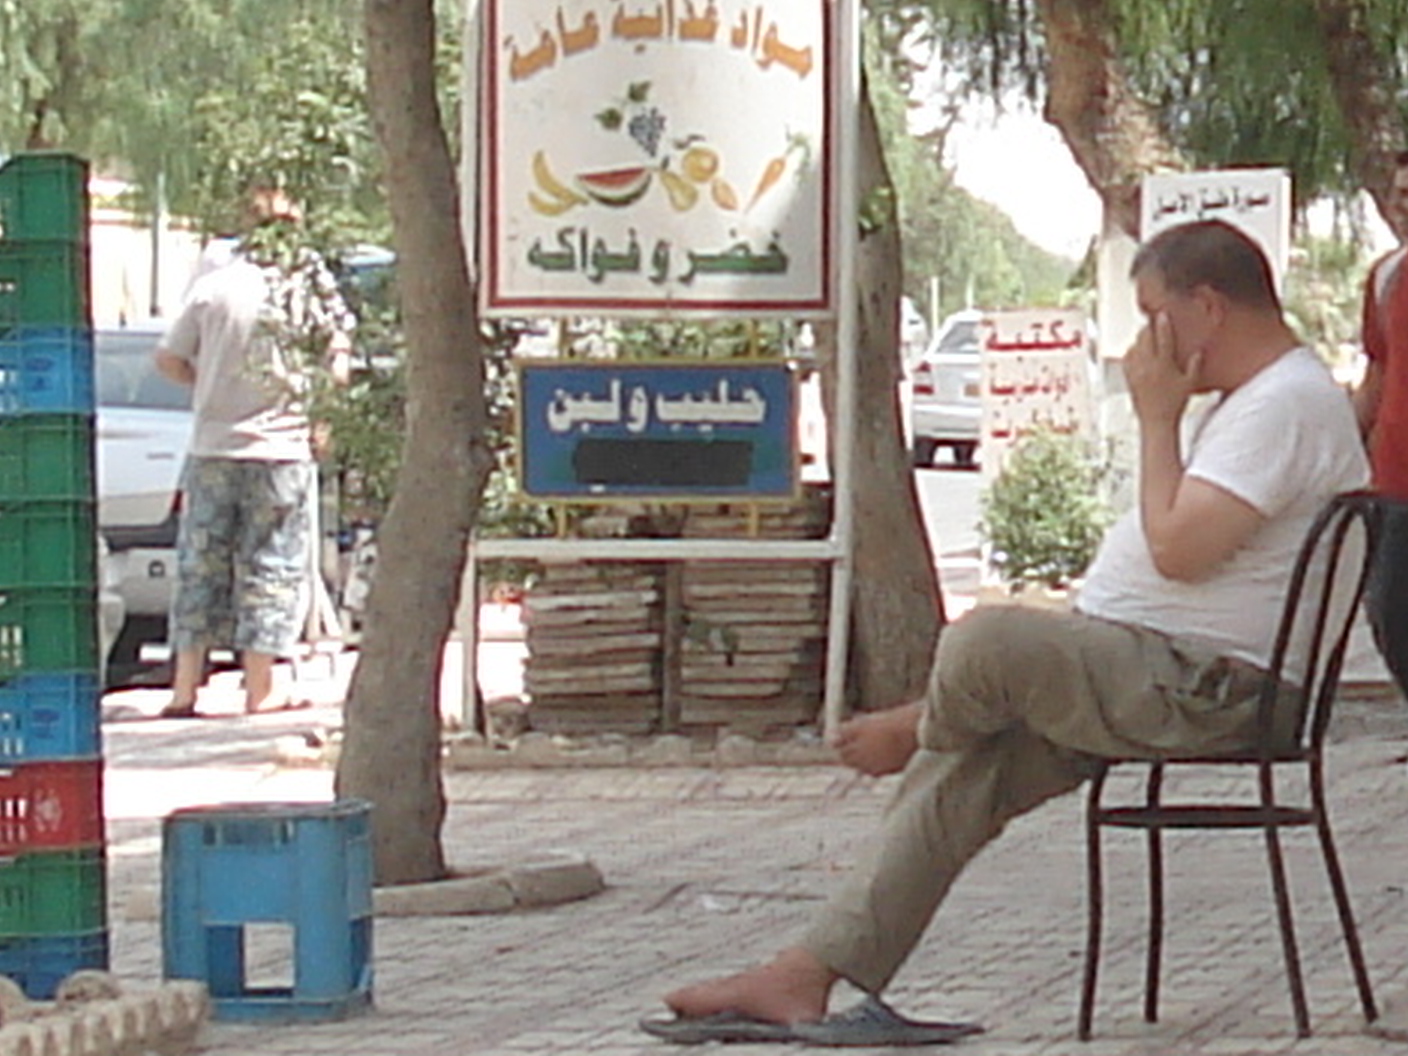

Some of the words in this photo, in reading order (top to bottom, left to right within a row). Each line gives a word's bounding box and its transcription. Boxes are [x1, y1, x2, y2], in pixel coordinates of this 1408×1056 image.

[729, 5, 815, 79] مواد
[979, 319, 1082, 361] مكتبة
[656, 378, 767, 432] حليب
